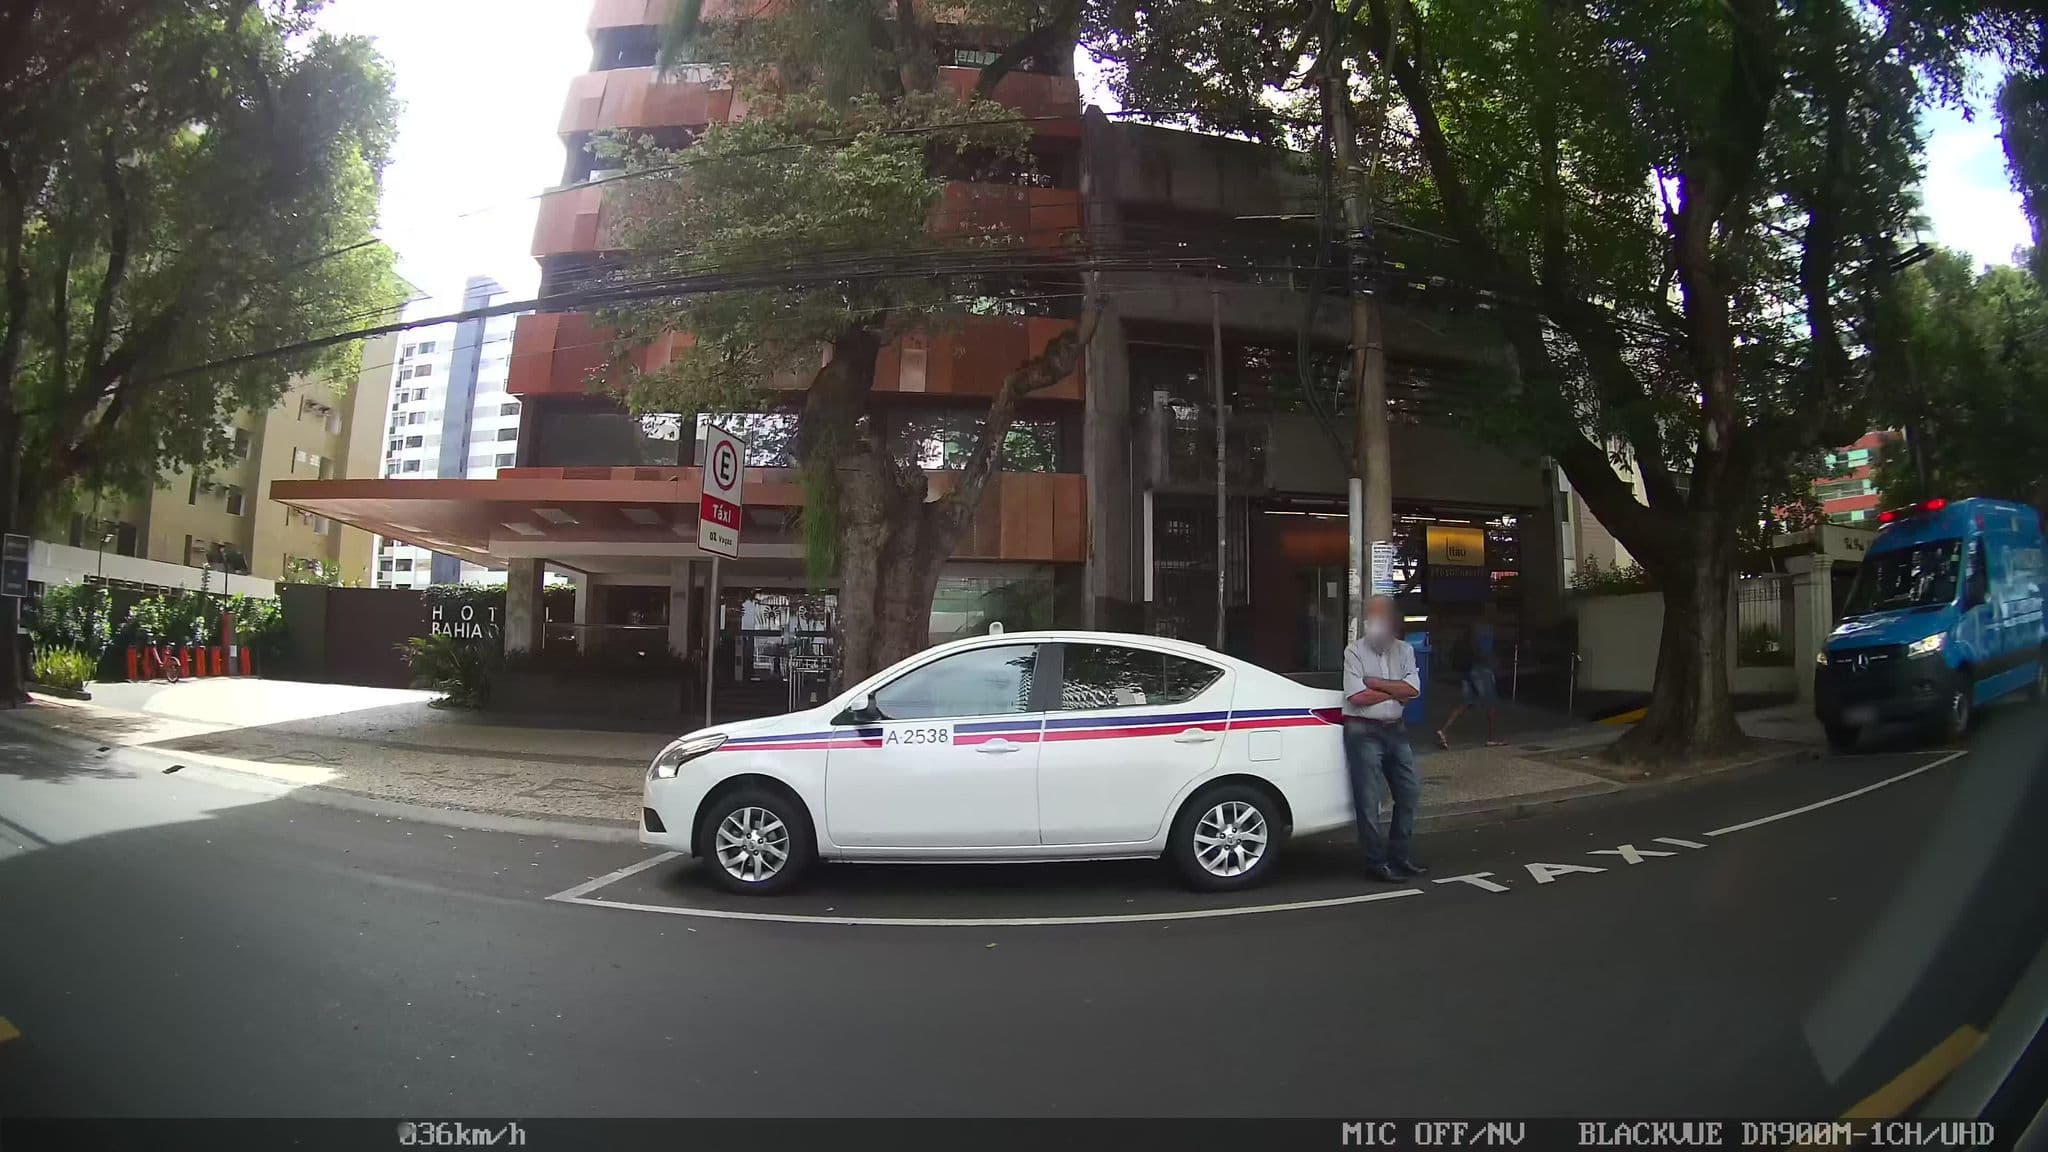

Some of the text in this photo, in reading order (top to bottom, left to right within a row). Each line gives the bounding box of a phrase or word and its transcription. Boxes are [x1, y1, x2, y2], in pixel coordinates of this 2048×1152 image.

[720, 451, 730, 480] E
[886, 728, 948, 744] A-2538
[1432, 837, 1708, 892] TAXI
